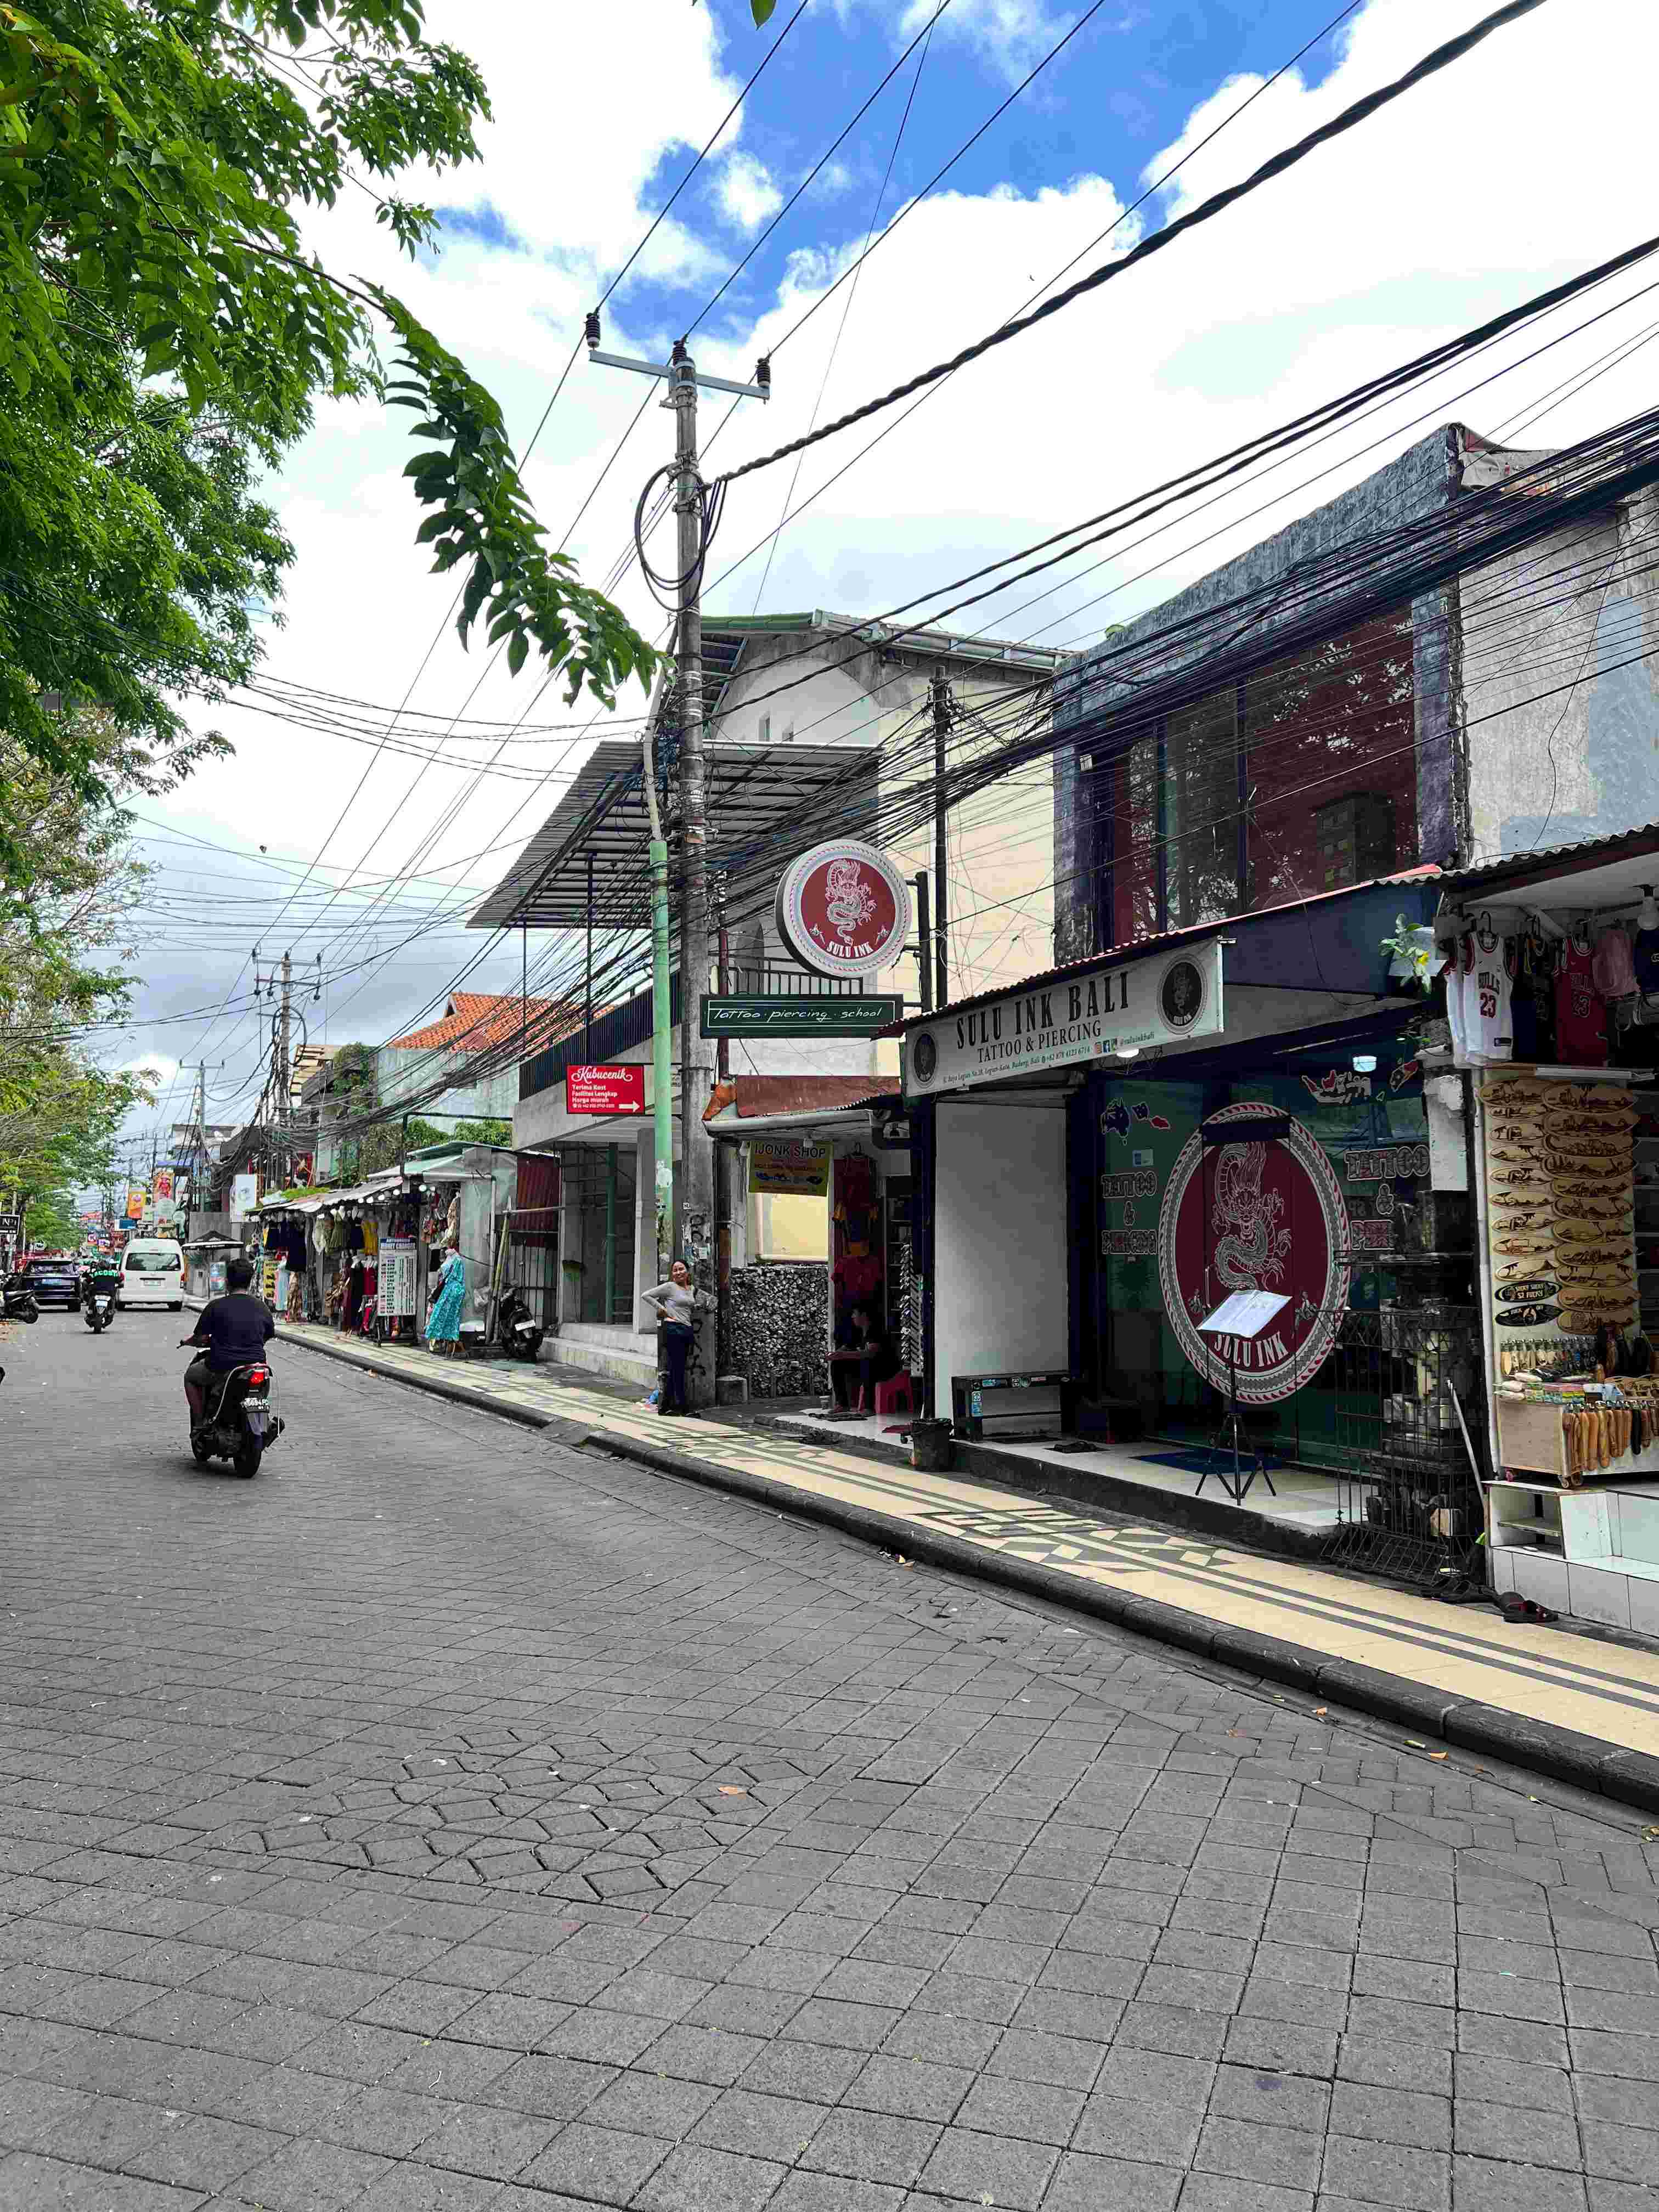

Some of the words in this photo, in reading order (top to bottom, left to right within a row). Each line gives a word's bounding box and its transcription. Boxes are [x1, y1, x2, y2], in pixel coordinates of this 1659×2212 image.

[827, 941, 851, 957] SULU
[854, 941, 874, 957] INK
[766, 1009, 832, 1023] piercing
[840, 1007, 883, 1019] school
[957, 1007, 1001, 1049] SULU
[1015, 992, 1054, 1035] INK
[1068, 971, 1129, 1023] BALI
[1479, 992, 1497, 1019] 23
[978, 1039, 1022, 1063] TATTOO
[1026, 1036, 1034, 1052] &
[1039, 1019, 1102, 1049] PIERCING
[571, 1066, 633, 1085] Kubucenik
[794, 1145, 826, 1158] SHOP
[1344, 1144, 1430, 1181] TATTOO
[1101, 1170, 1158, 1199] TATTOO
[1376, 1183, 1395, 1215] &
[1124, 1200, 1136, 1226] &
[1101, 1229, 1158, 1255] PIERCING
[1214, 1334, 1251, 1368] SULU
[1256, 1331, 1289, 1368] INK
